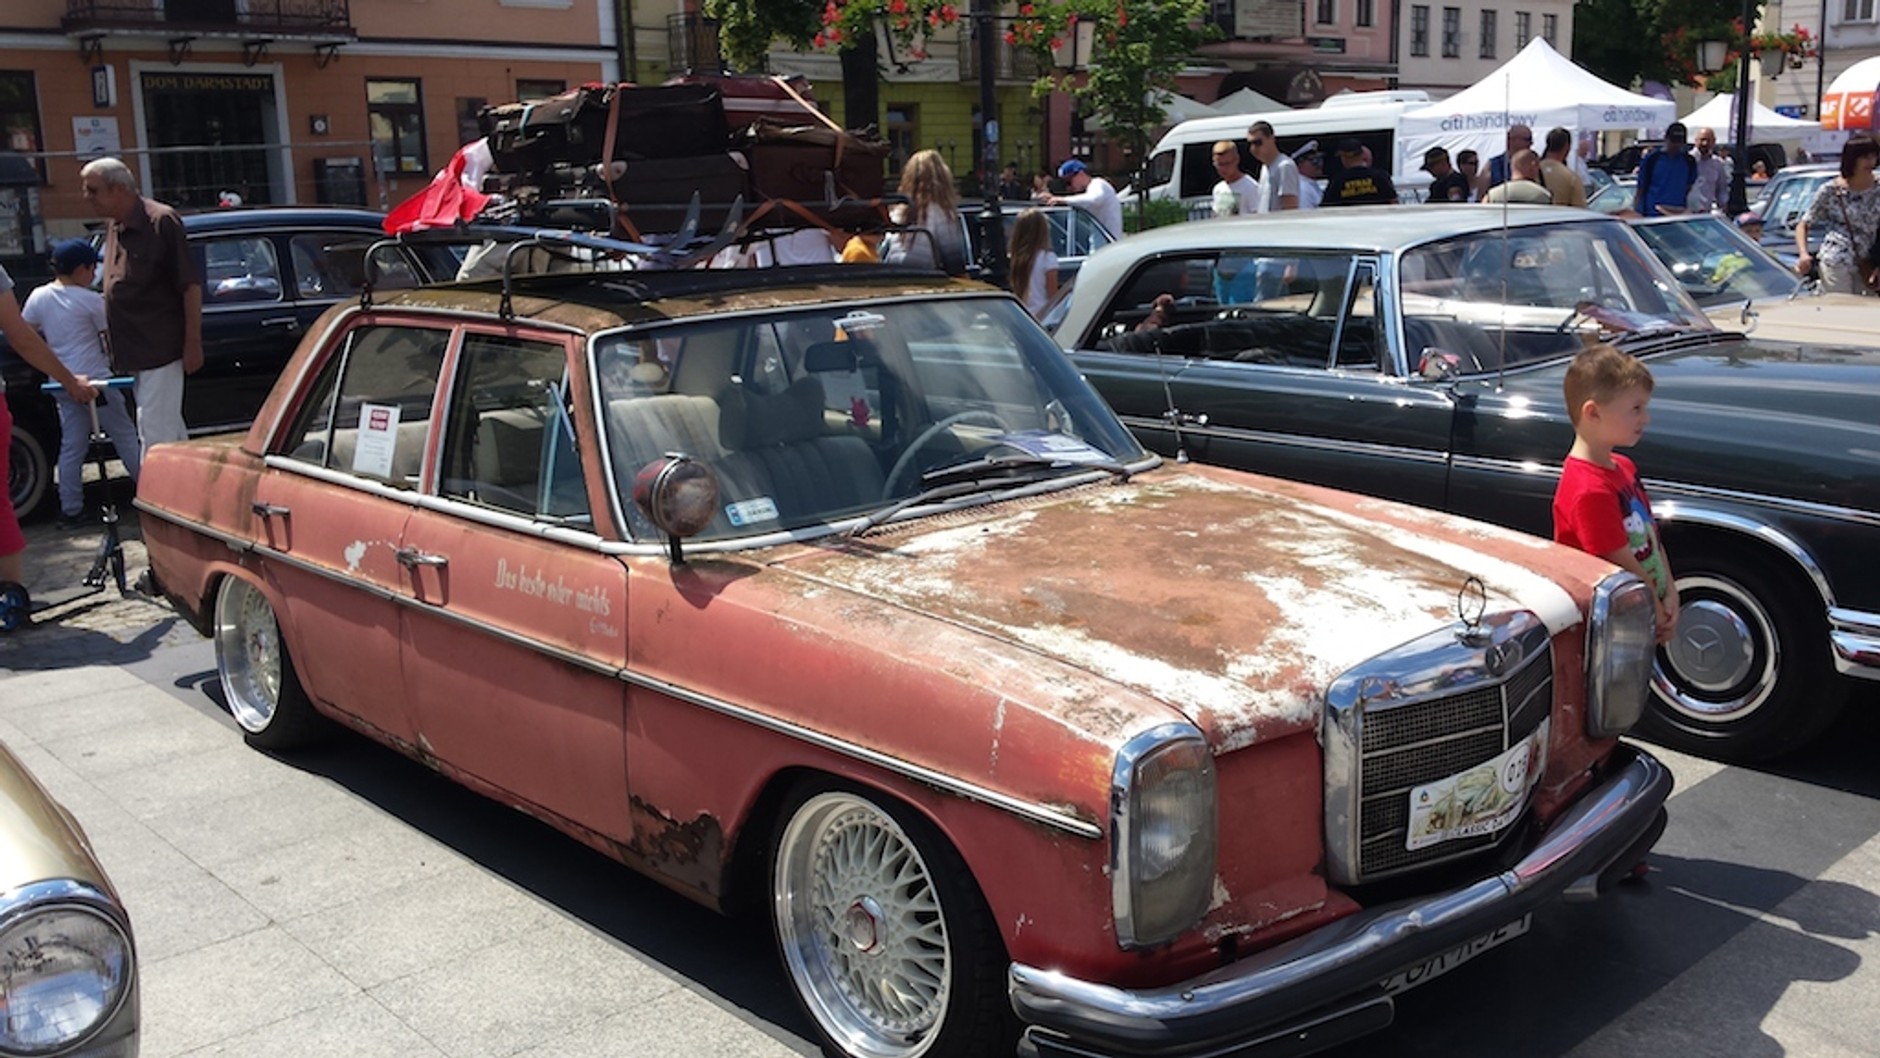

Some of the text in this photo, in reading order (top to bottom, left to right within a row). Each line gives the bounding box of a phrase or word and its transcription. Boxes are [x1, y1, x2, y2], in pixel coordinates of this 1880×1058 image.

[144, 76, 271, 91] DOM DARMSTADT
[1440, 111, 1538, 131] citi handlowy
[495, 558, 517, 590] Das
[575, 584, 611, 617] nichts
